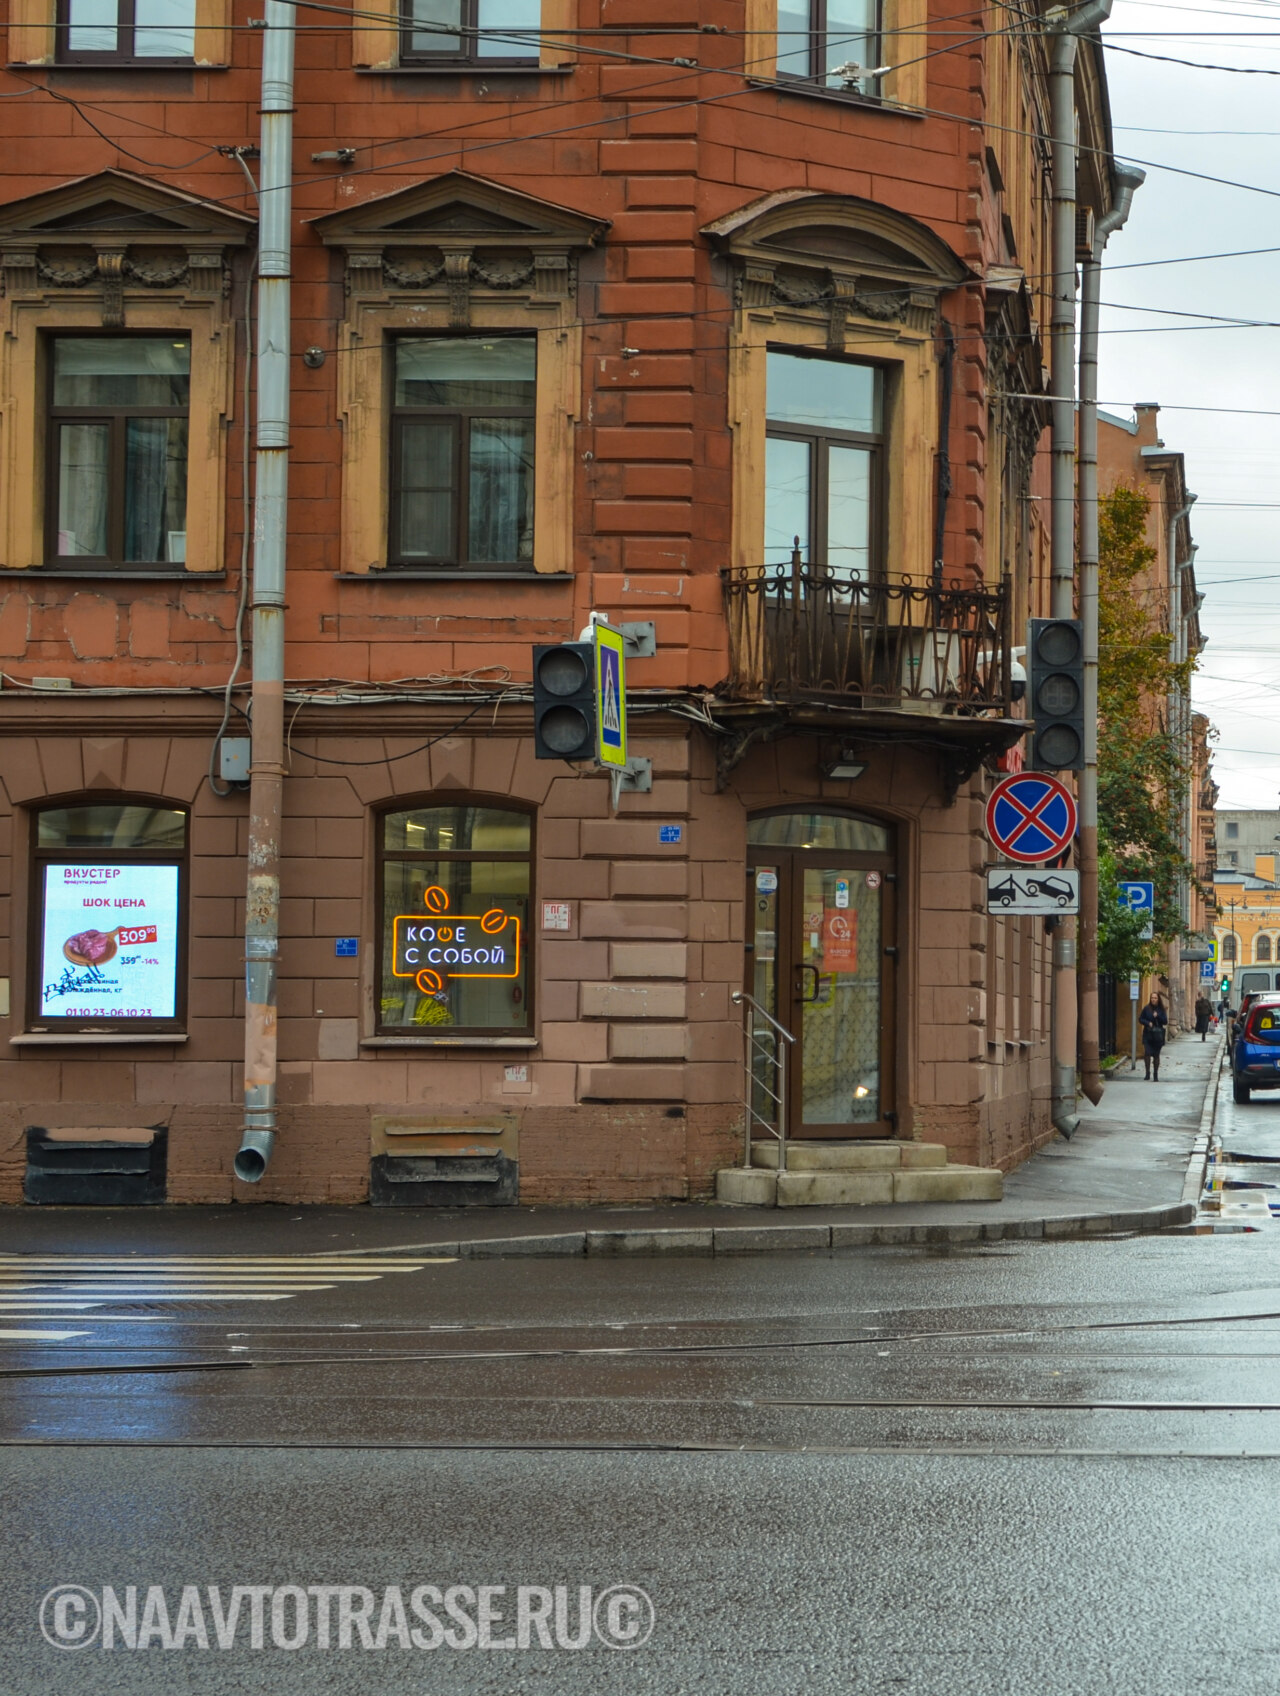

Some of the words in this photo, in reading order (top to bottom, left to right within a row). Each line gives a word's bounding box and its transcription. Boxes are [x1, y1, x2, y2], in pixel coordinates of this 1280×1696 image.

[64, 868, 121, 878] ВКУСТЕР
[1127, 886, 1147, 908] P
[83, 898, 111, 907] ШОК
[114, 898, 146, 908] ЦЕНА
[120, 929, 147, 943] 309
[840, 930, 851, 938] 24
[405, 948, 419, 964] С
[428, 946, 504, 964] СОБОЙ
[120, 956, 136, 965] 359
[1203, 963, 1212, 975] P
[65, 1007, 153, 1017] 01.10.23-06.10.23
